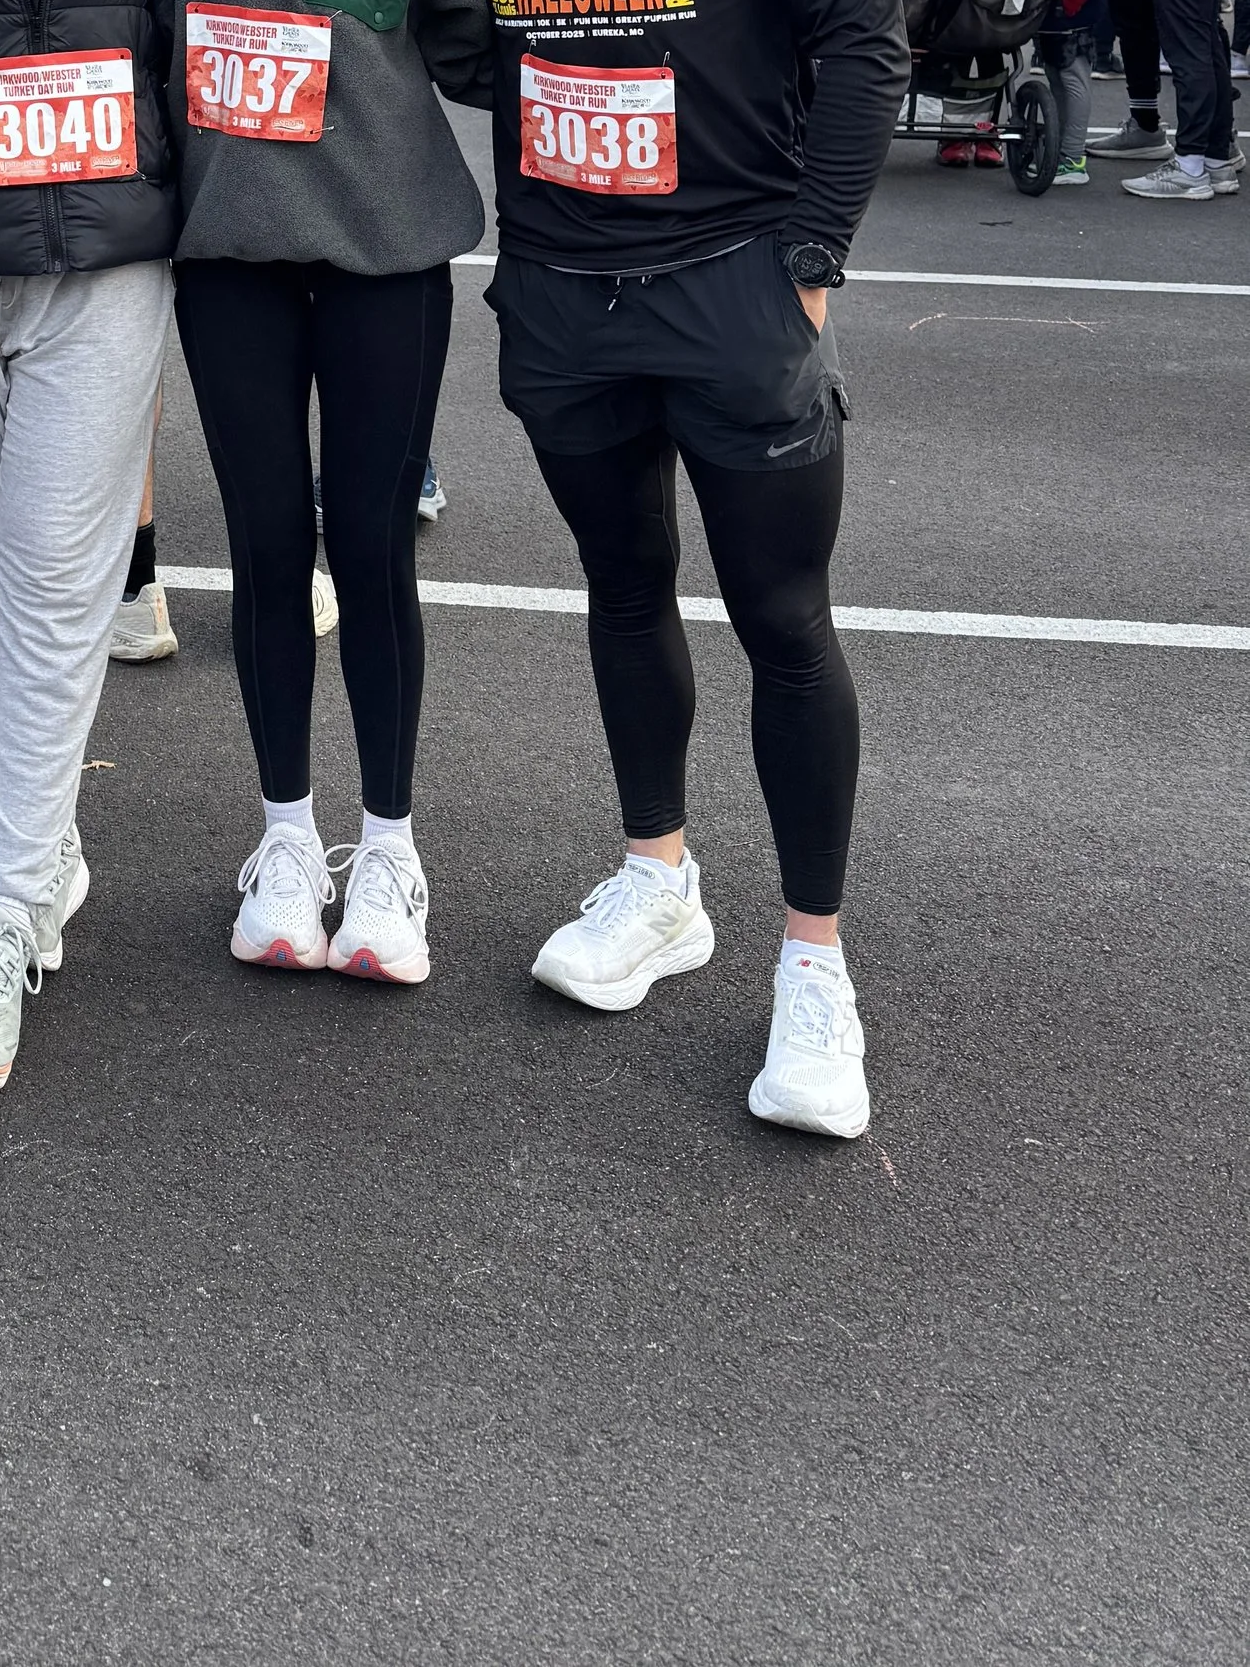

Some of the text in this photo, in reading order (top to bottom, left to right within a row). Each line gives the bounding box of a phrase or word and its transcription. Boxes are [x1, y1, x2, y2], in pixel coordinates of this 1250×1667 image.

[504, 19, 533, 27] MARATHON
[536, 19, 551, 27] 10K
[556, 18, 567, 26] 5K
[573, 17, 591, 26] FUN
[592, 16, 609, 25] RUN
[615, 16, 642, 24] GREAT
[678, 10, 697, 20] RUN
[526, 28, 644, 40] OCTOBER 2025 EUREKA, MO
[235, 36, 247, 49] DAY
[249, 38, 268, 51] RUN
[4, 84, 36, 97] TURKEY
[38, 83, 54, 96] DAY
[57, 81, 75, 94] RUN
[200, 50, 312, 114] 3037
[533, 74, 616, 97] KIRKWOOD/WEBSTER
[540, 88, 567, 104] TURKEY
[569, 93, 586, 107] DAY
[588, 95, 607, 109] RUN
[232, 116, 239, 126] 3
[240, 117, 262, 129] MILE
[531, 104, 659, 170] 3038
[51, 162, 59, 172] 3
[60, 160, 82, 173] MILE
[580, 172, 587, 182] 3
[588, 173, 612, 185] MILE
